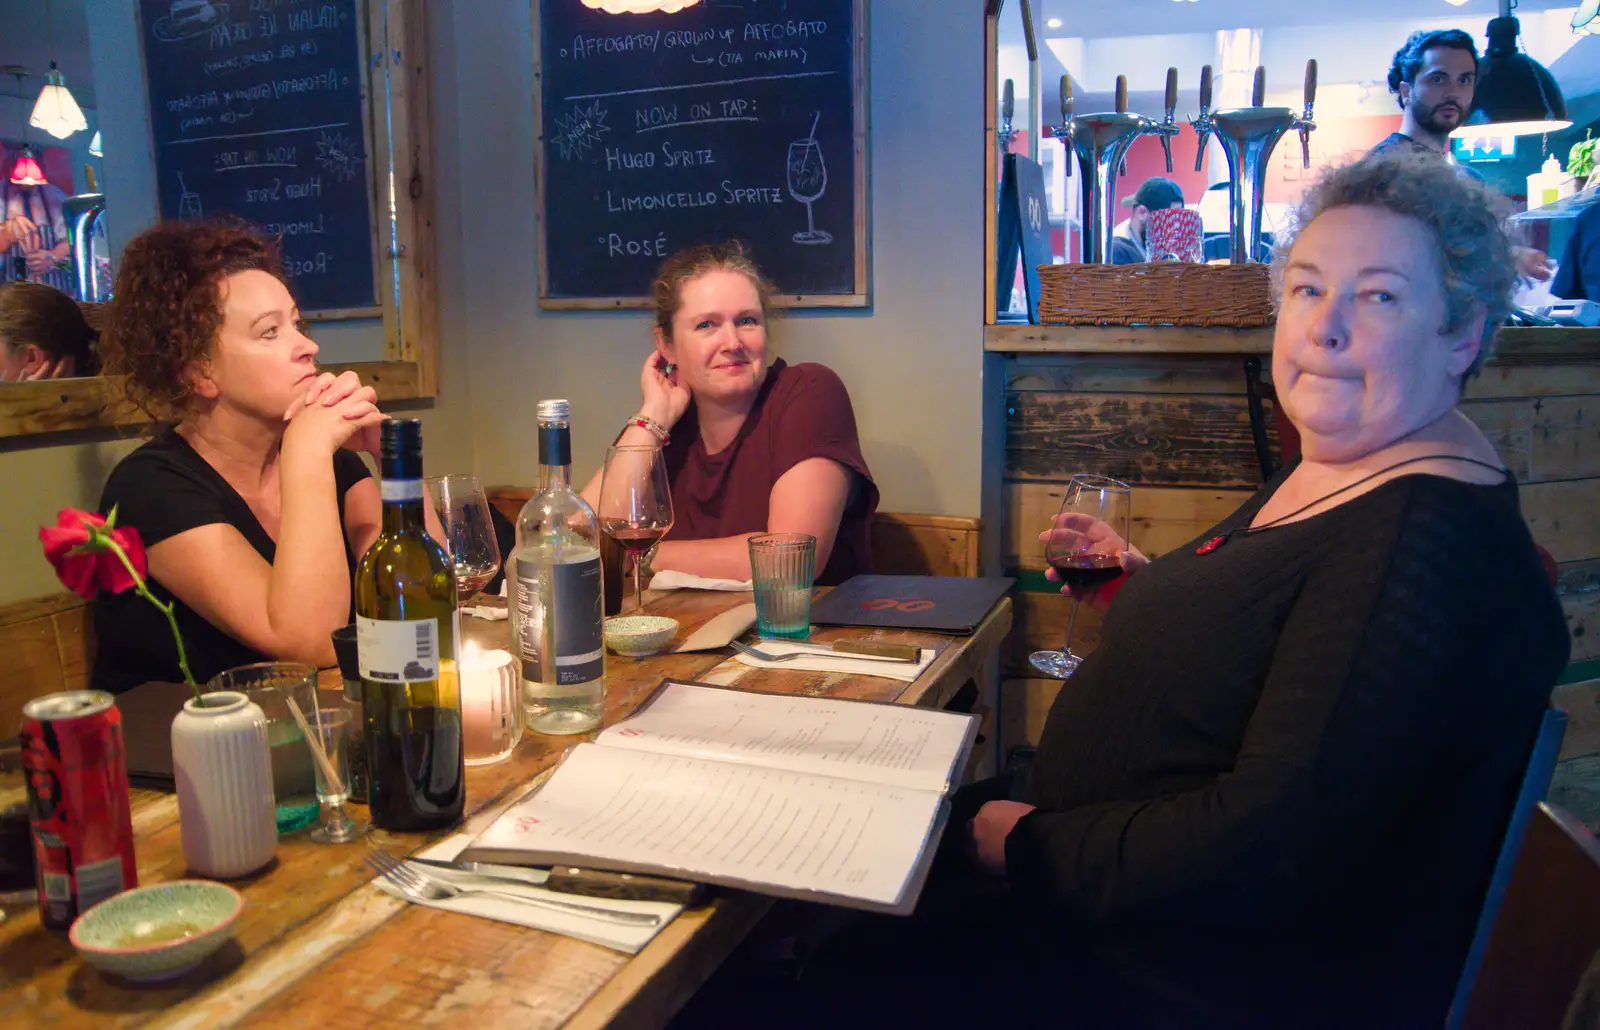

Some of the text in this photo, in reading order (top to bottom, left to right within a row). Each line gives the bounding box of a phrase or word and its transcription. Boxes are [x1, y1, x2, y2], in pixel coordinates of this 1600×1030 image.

[744, 20, 827, 41] AFFOGATO
[636, 99, 757, 127] NOW ON TAP:
[567, 119, 592, 142] NEW
[606, 141, 716, 171] HUGO SPRITZ
[608, 180, 783, 212] LIMONCELLO SPRITZ
[608, 232, 668, 257] ROSÉ
